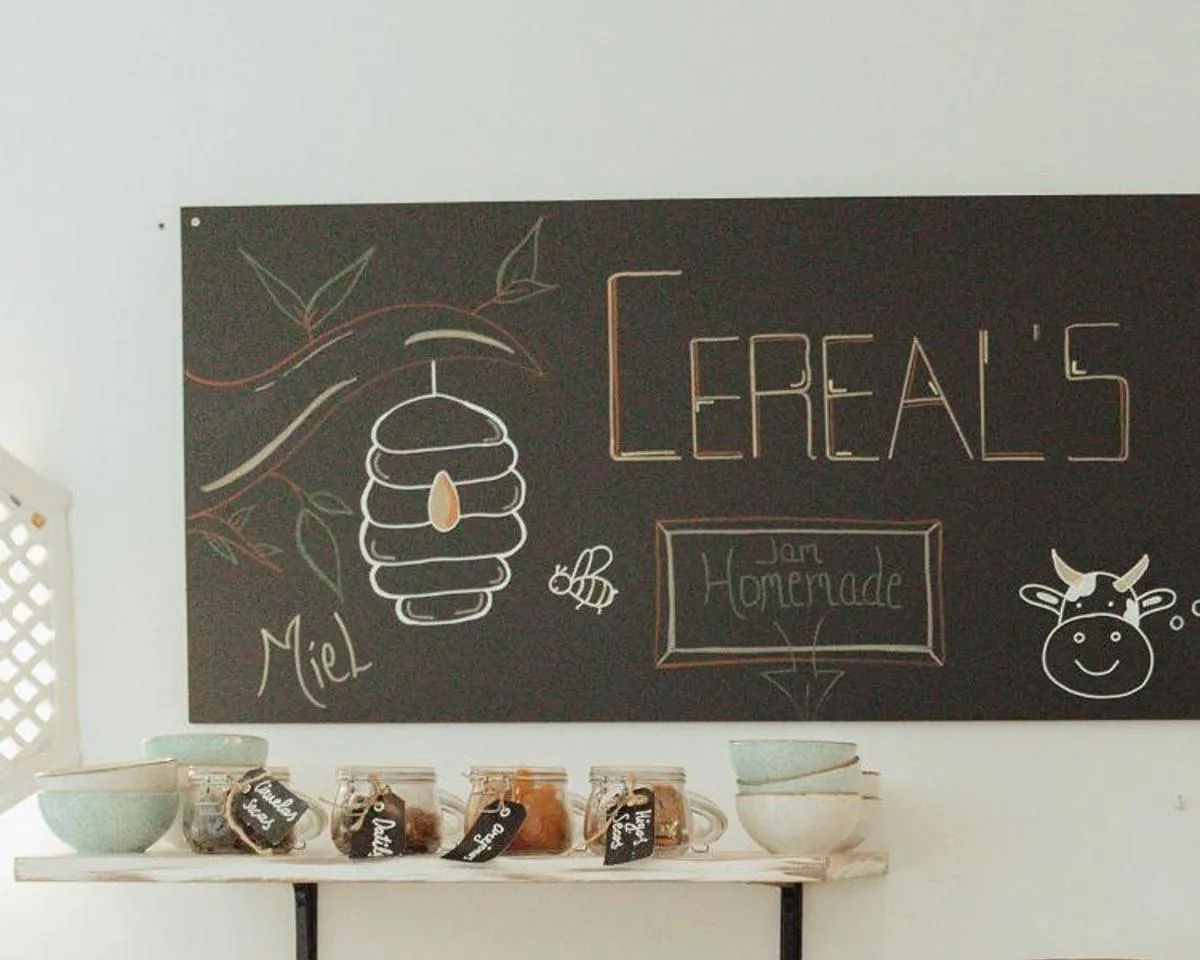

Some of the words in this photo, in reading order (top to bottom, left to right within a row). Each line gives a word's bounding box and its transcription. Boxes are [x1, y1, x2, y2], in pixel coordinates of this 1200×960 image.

[606, 269, 1130, 462] CEREAL'S
[700, 546, 904, 620] Homemade
[755, 536, 824, 565] Jam
